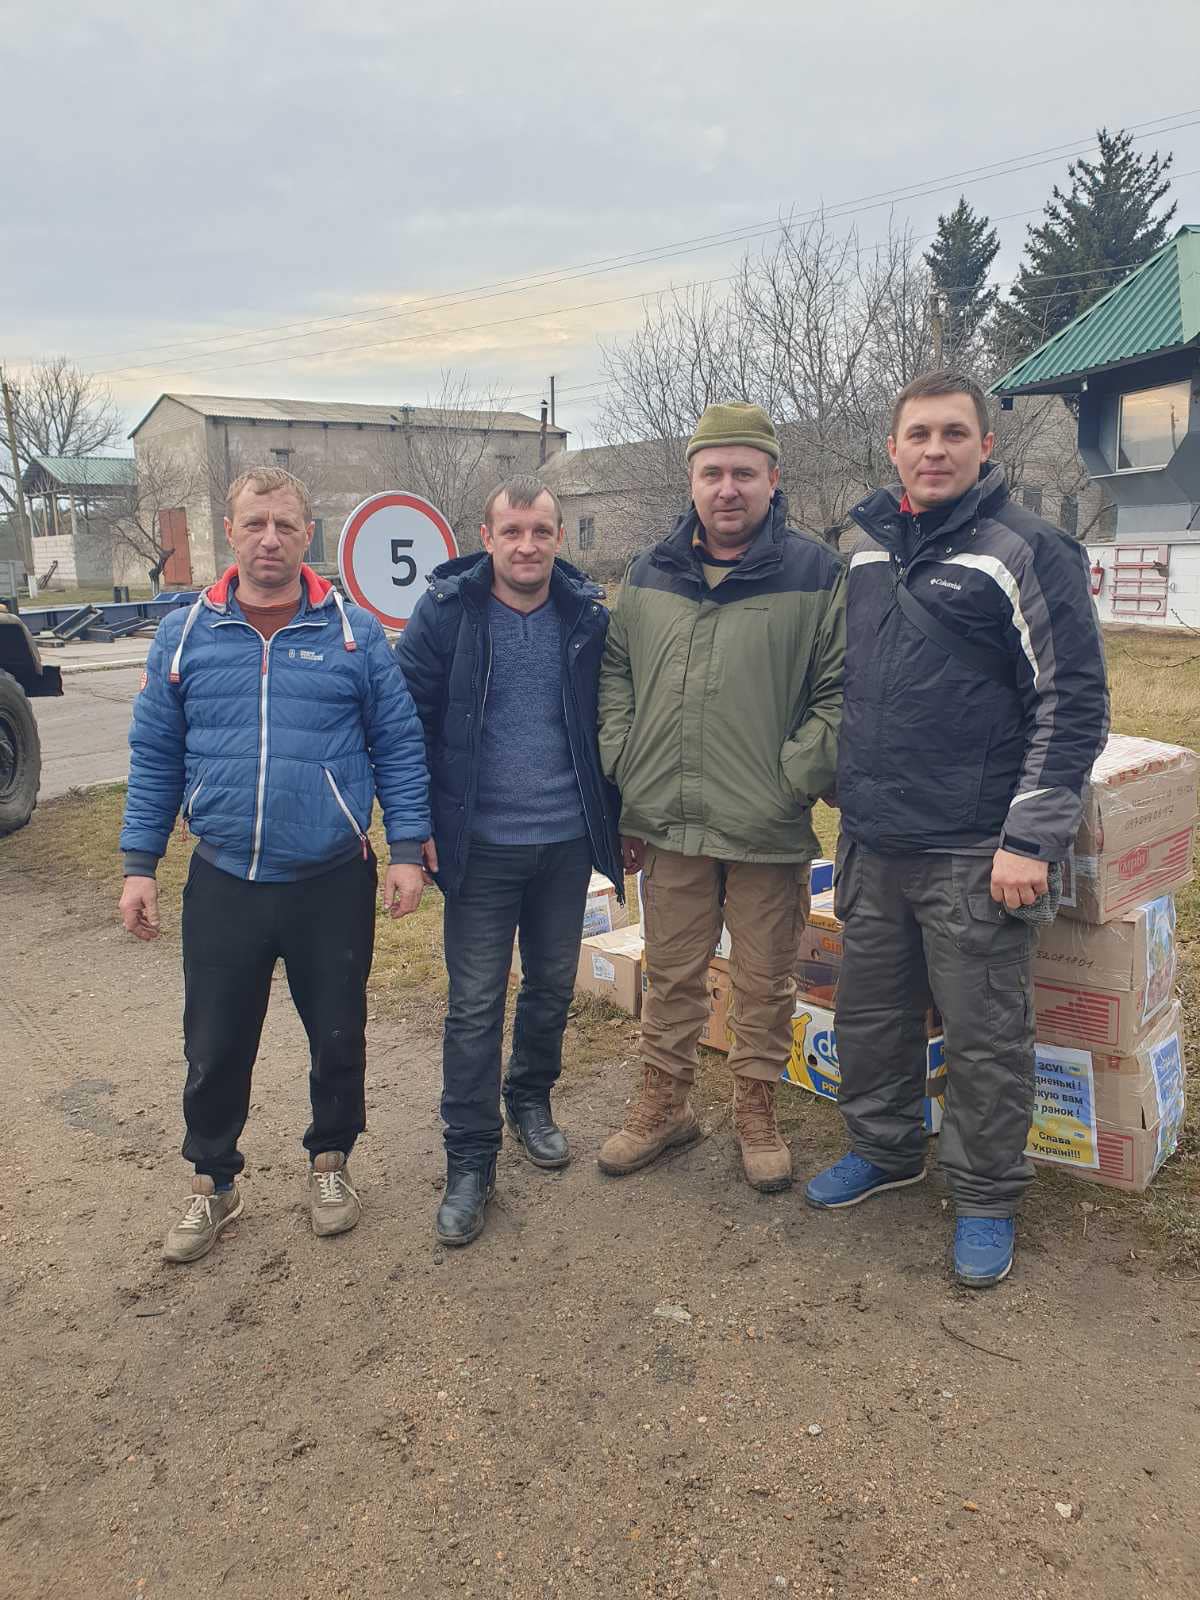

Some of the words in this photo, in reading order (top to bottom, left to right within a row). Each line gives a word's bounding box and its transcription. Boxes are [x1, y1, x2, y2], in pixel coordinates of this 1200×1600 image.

[391, 539, 417, 587] 5
[1034, 1075, 1076, 1090] дненькі
[1035, 1089, 1059, 1101] кую
[1062, 1094, 1083, 1105] вам
[1039, 1131, 1072, 1145] Слава
